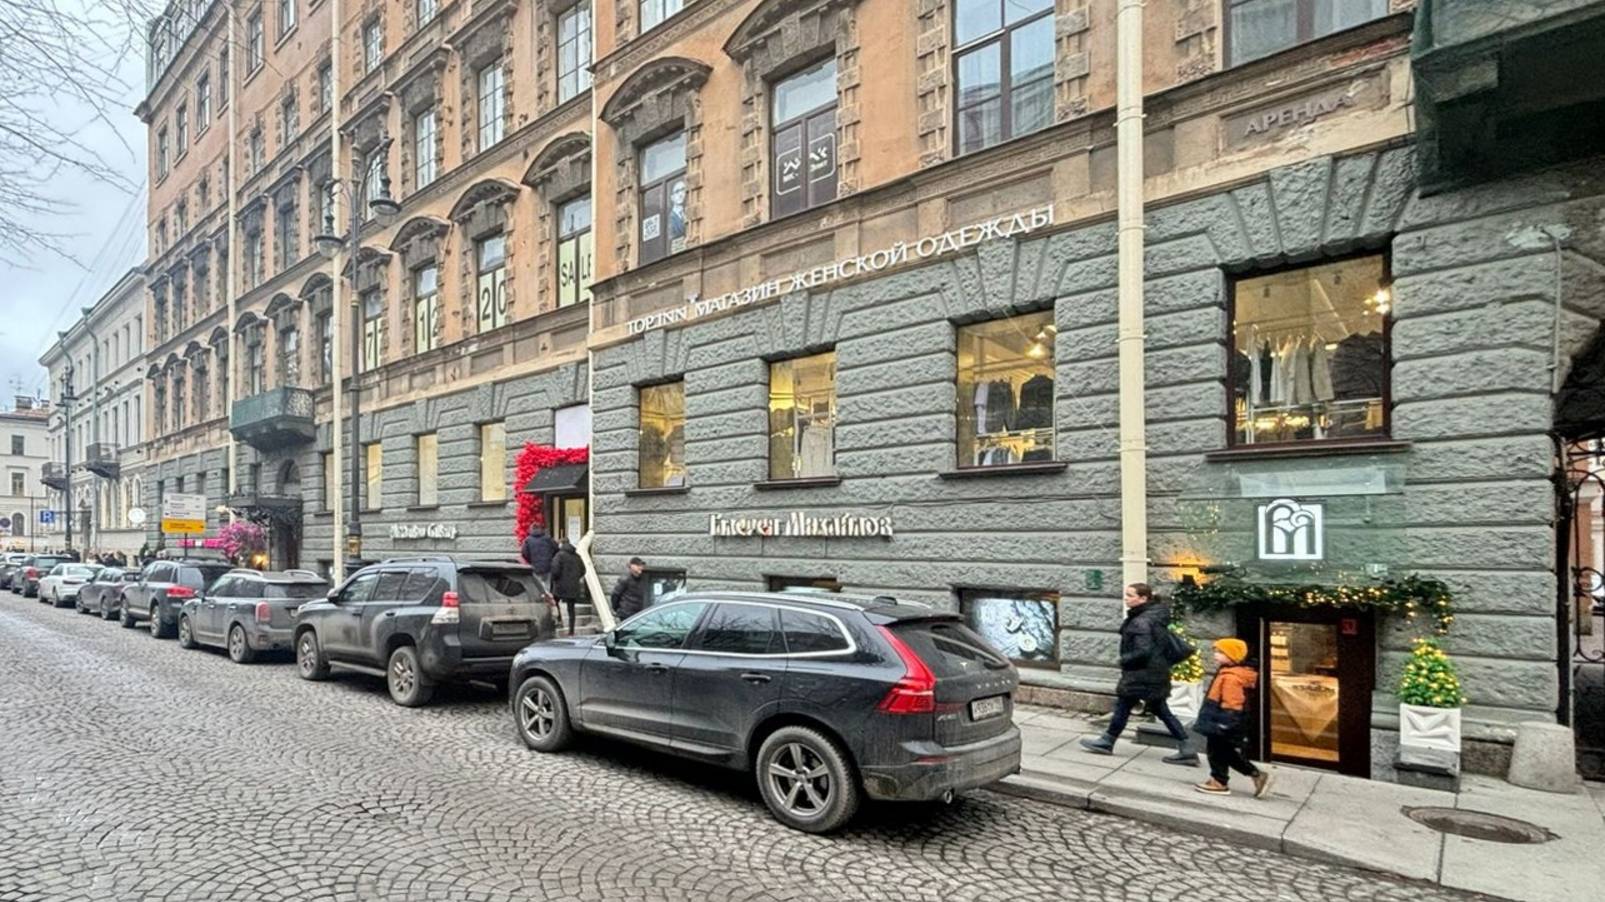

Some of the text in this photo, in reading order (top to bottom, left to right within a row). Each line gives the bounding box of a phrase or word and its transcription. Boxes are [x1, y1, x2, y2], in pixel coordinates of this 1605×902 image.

[1244, 94, 1357, 136] АРЕНДА
[694, 280, 780, 318] МАГАЗИН
[788, 241, 908, 291] ЖЕНСКОЙ
[916, 204, 1055, 257] ОДЕЖДЫ
[784, 511, 894, 537] Михайлов
